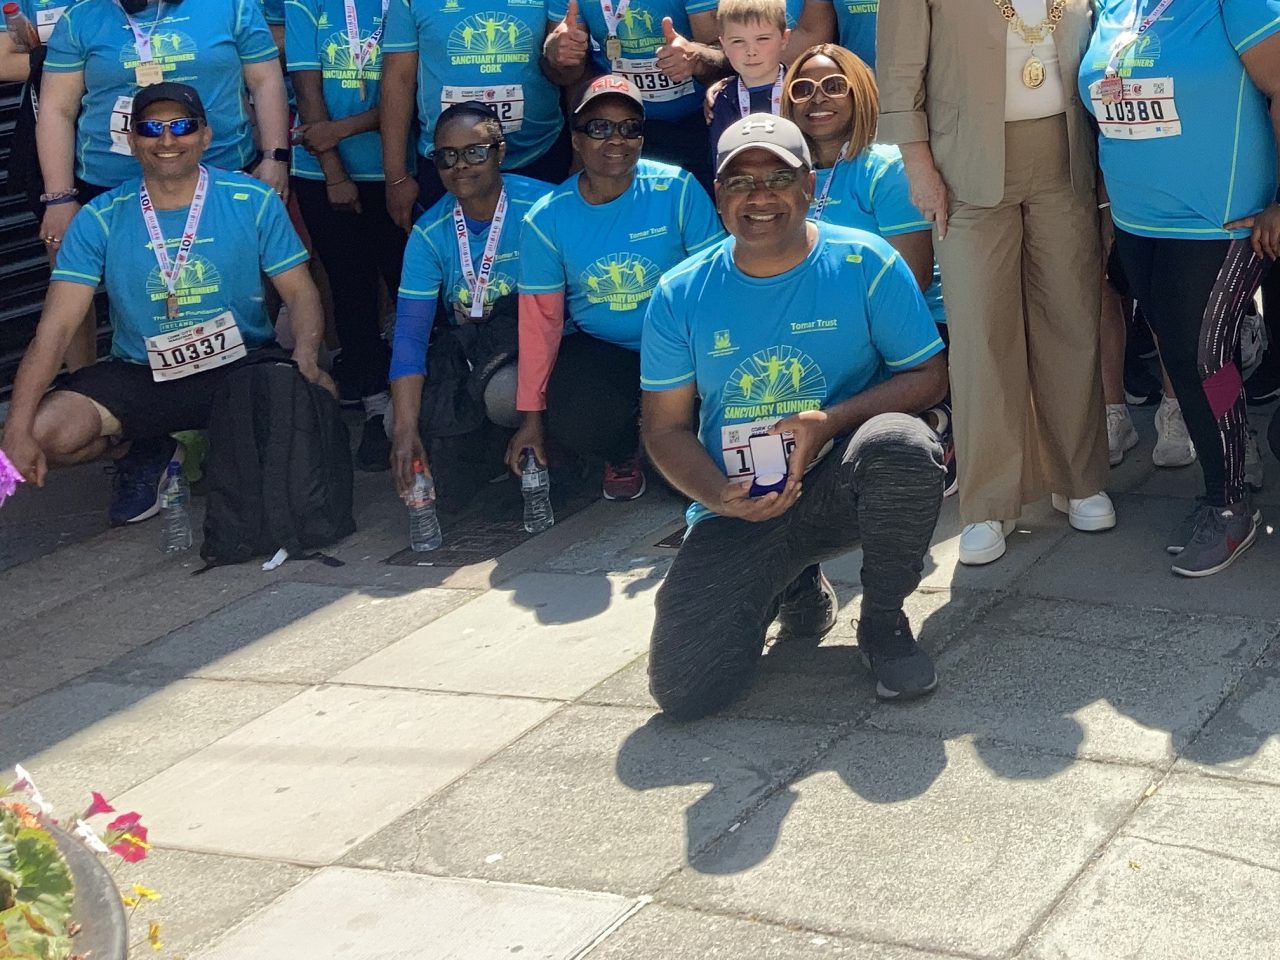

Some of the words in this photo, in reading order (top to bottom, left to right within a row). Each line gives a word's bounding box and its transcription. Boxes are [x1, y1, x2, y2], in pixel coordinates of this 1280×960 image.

[451, 54, 495, 65] SANCTUARY
[497, 53, 529, 63] RUNNERS
[480, 64, 502, 74] CORK
[1105, 100, 1164, 122] 10380
[140, 193, 153, 214] 10K
[456, 219, 467, 239] 10K
[628, 231, 649, 240] Tomar
[650, 226, 667, 235] Trust
[180, 232, 194, 252] 10K
[481, 255, 494, 276] 10K
[790, 322, 815, 331] Tomar
[817, 319, 837, 328] Trust
[157, 333, 226, 368] 10337
[724, 404, 774, 419] SANCTUARY
[776, 400, 821, 415] RUNNERS
